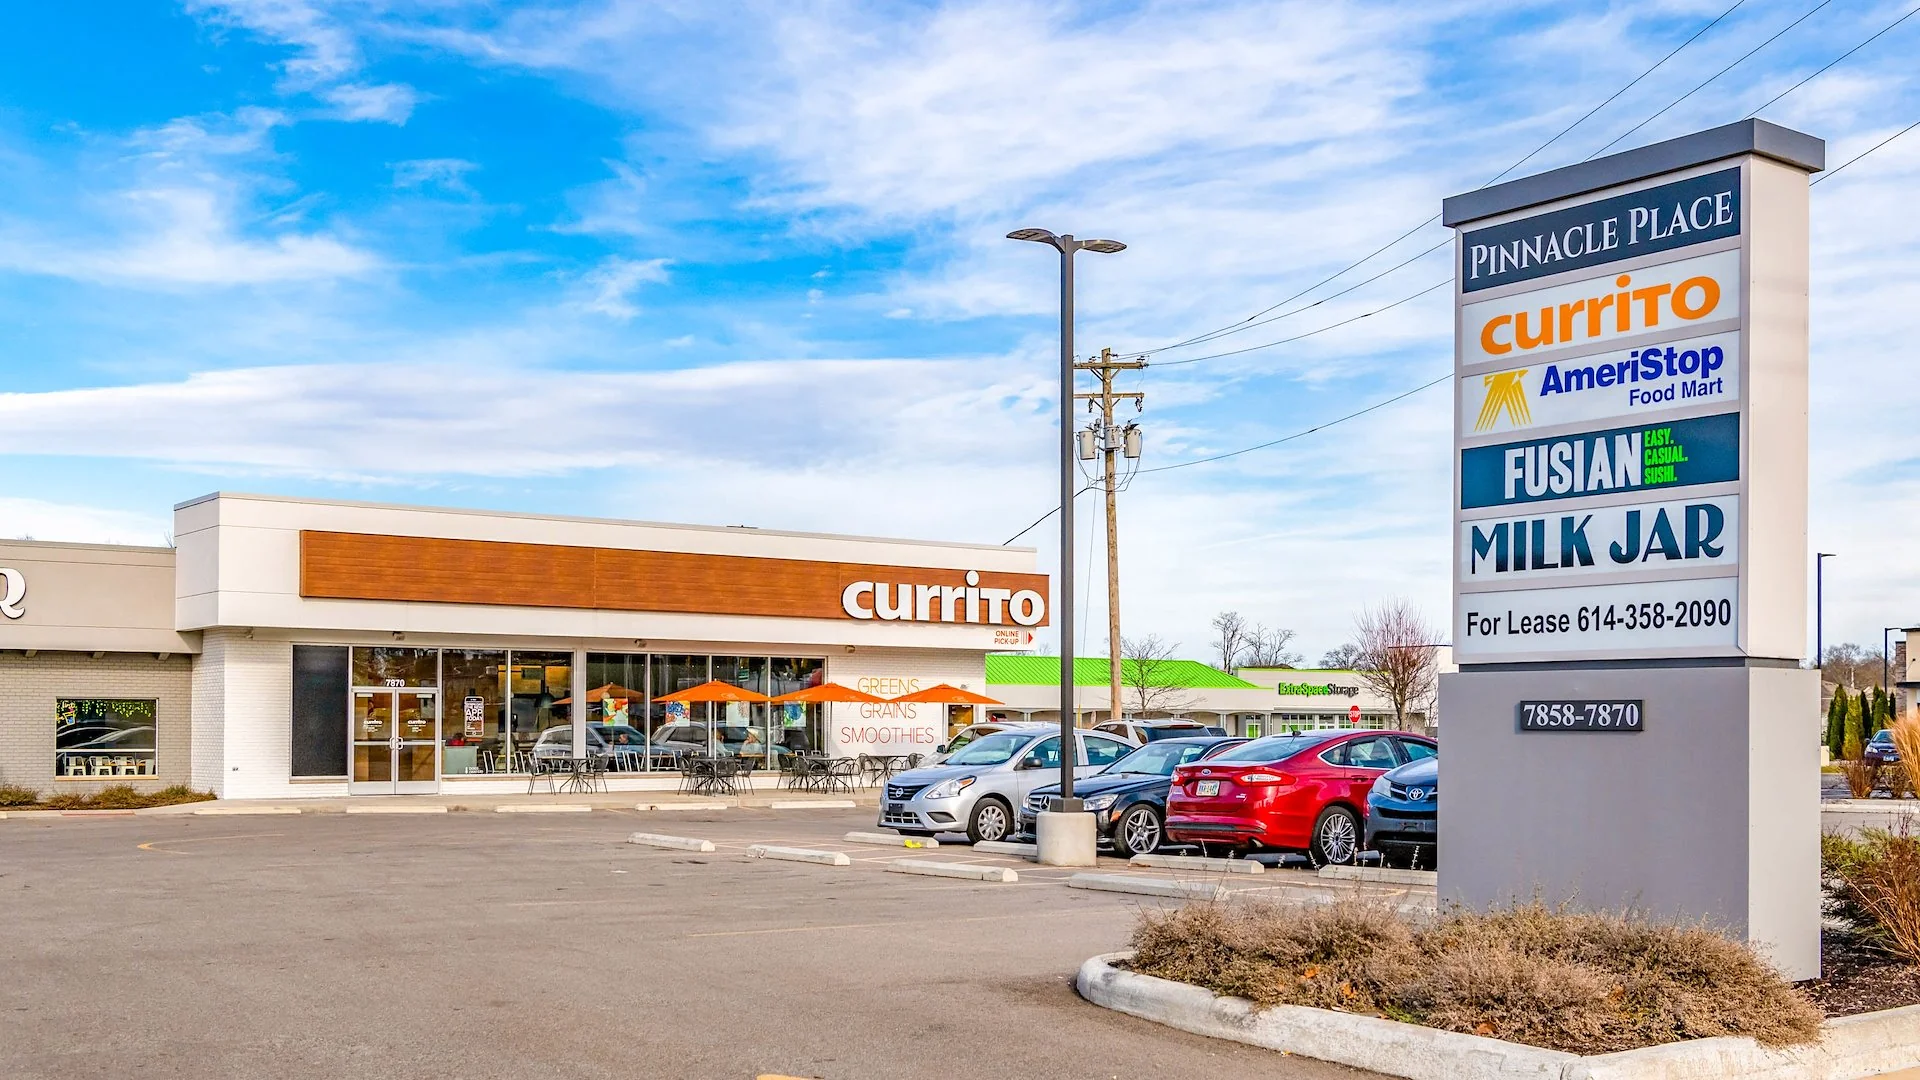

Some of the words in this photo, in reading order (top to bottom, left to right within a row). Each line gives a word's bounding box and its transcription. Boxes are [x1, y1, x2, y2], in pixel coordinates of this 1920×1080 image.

[1470, 217, 1619, 280] PINNACLE
[1627, 190, 1735, 246] PLACE
[1539, 345, 1724, 397] AmeriStop
[1629, 388, 1676, 406] Food
[1681, 377, 1723, 399] Mart
[1644, 428, 1675, 448] EASY.
[1644, 445, 1689, 466] CASUAL.
[1504, 432, 1642, 500] FUSIAN
[1644, 465, 1678, 485] SUSHI.
[1471, 514, 1595, 575] MILK
[1609, 503, 1725, 564] JAR
[1467, 613, 1501, 637] For
[1507, 609, 1570, 635] Lease
[1577, 598, 1732, 632] 614-358-2090
[994, 637, 1020, 645] PICK-UP
[995, 630, 1020, 638] ONLINE
[385, 678, 406, 687] 7870
[857, 677, 920, 696] GREENS
[466, 708, 483, 717] APP
[860, 702, 917, 719] GRAINS
[1349, 710, 1360, 718] STOP
[1523, 702, 1639, 728] 7858-7870
[840, 726, 935, 744] SMOOTHIES
